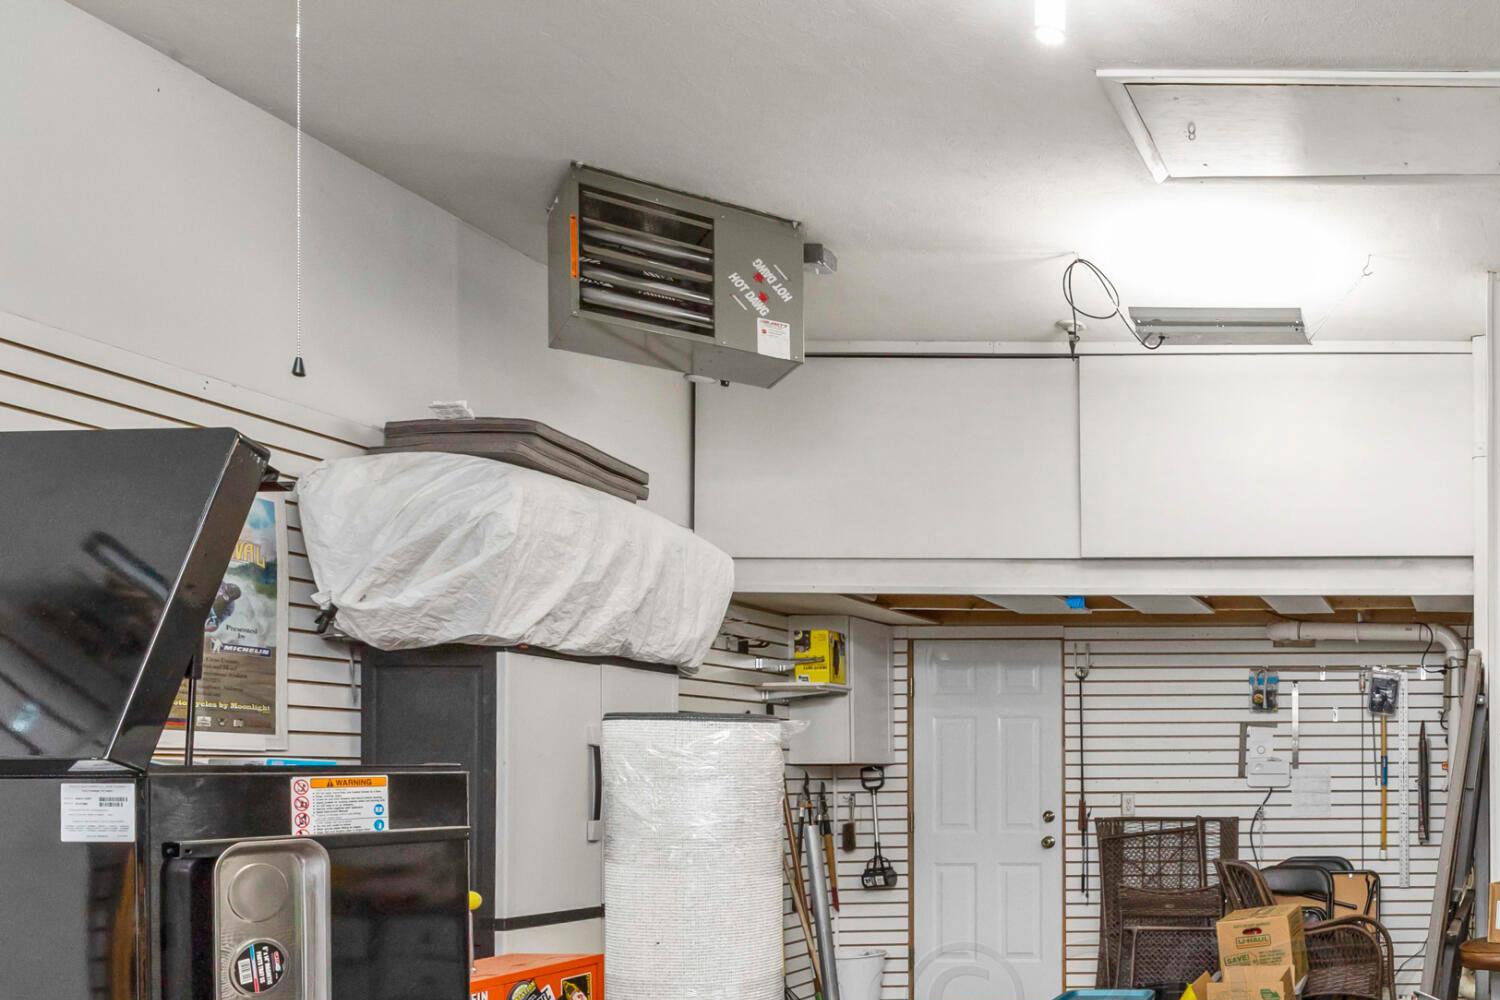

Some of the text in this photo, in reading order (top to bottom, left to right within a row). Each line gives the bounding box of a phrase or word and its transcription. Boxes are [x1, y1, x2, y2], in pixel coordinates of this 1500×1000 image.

[752, 258, 777, 285] DAWG
[728, 272, 770, 317] HOT DAWG
[771, 283, 793, 303] HOT
[225, 623, 258, 635] Presented
[223, 645, 270, 656] MICHELIN
[230, 701, 270, 712] Moonlight
[335, 778, 372, 787] WARNING
[1238, 935, 1269, 945] U-HAUL
[1226, 954, 1250, 965] SAVE!
